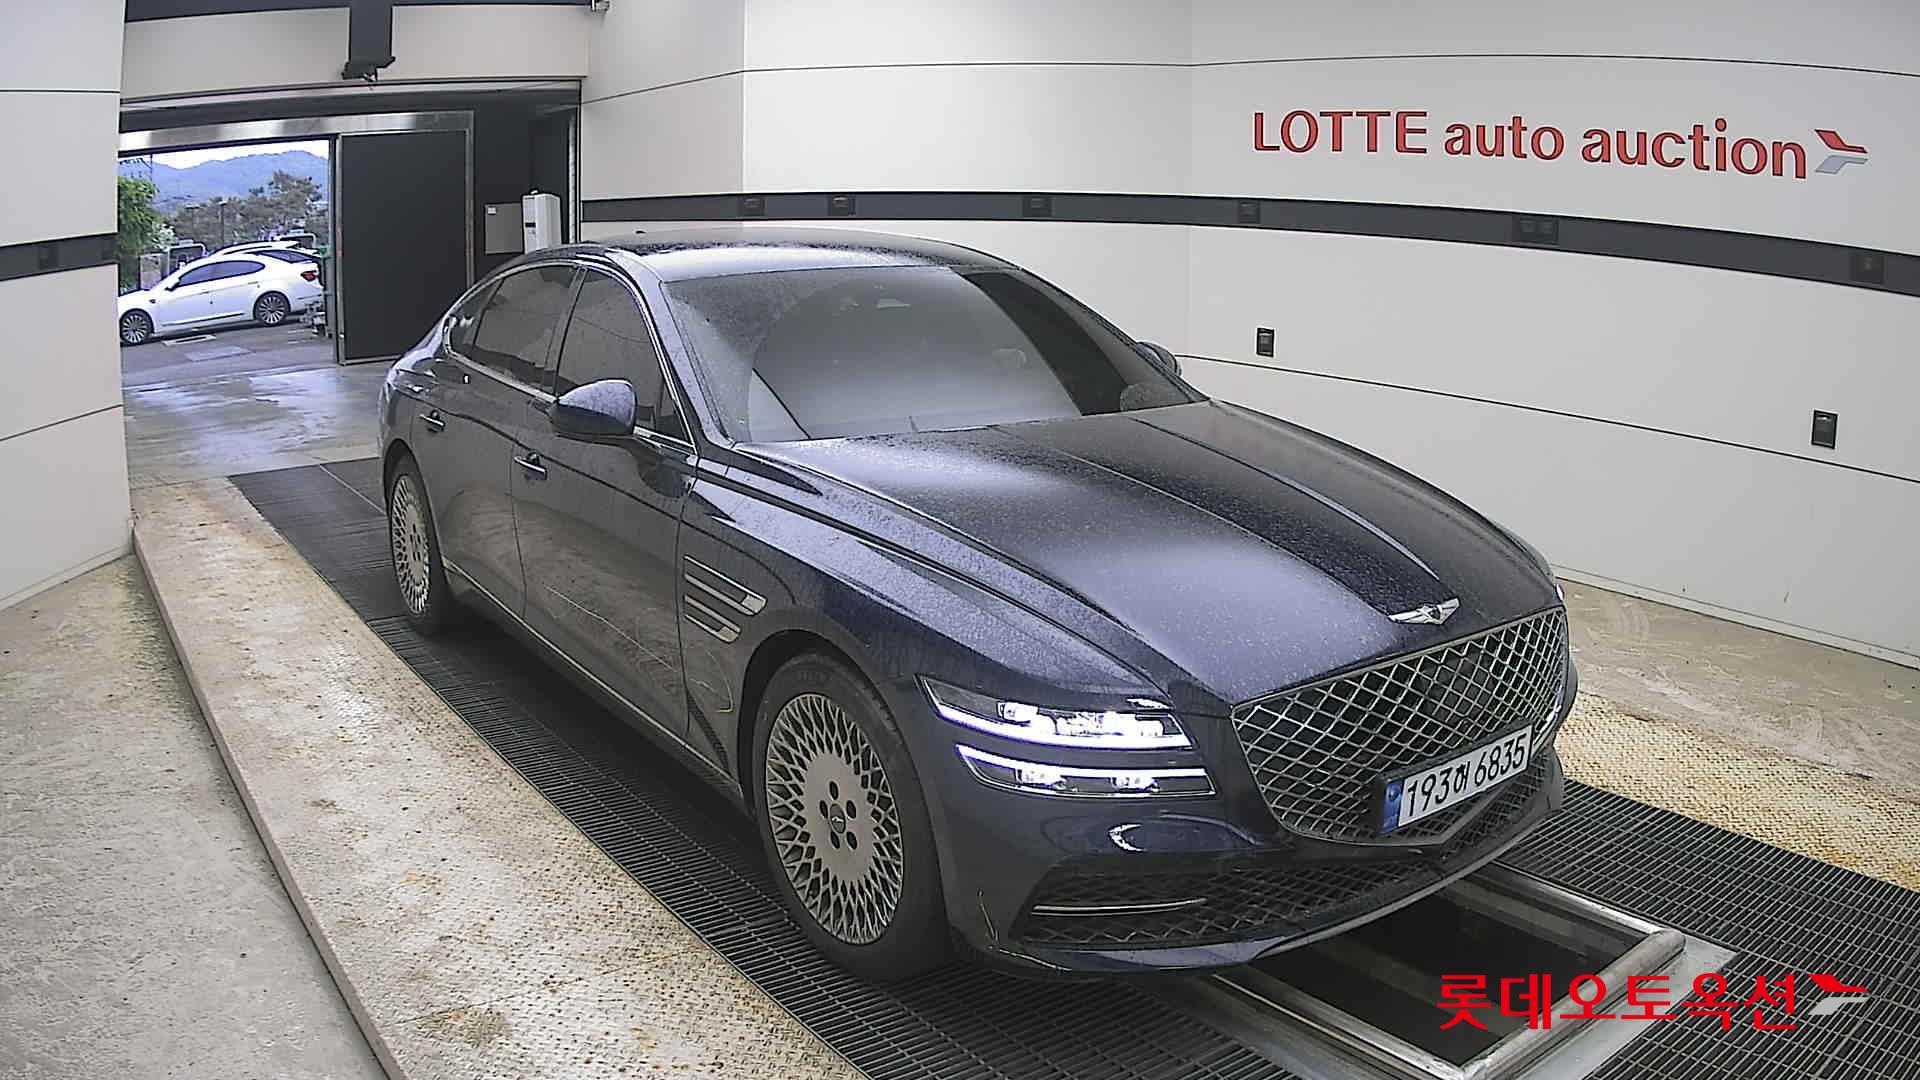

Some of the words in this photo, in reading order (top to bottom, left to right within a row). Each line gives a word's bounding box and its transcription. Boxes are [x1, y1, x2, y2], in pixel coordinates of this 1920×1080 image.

[1254, 111, 1427, 154] LOTTE
[1444, 115, 1565, 160] auto
[1582, 118, 1807, 179] auction
[1407, 760, 1471, 817] 193허
[1474, 733, 1528, 787] 6835
